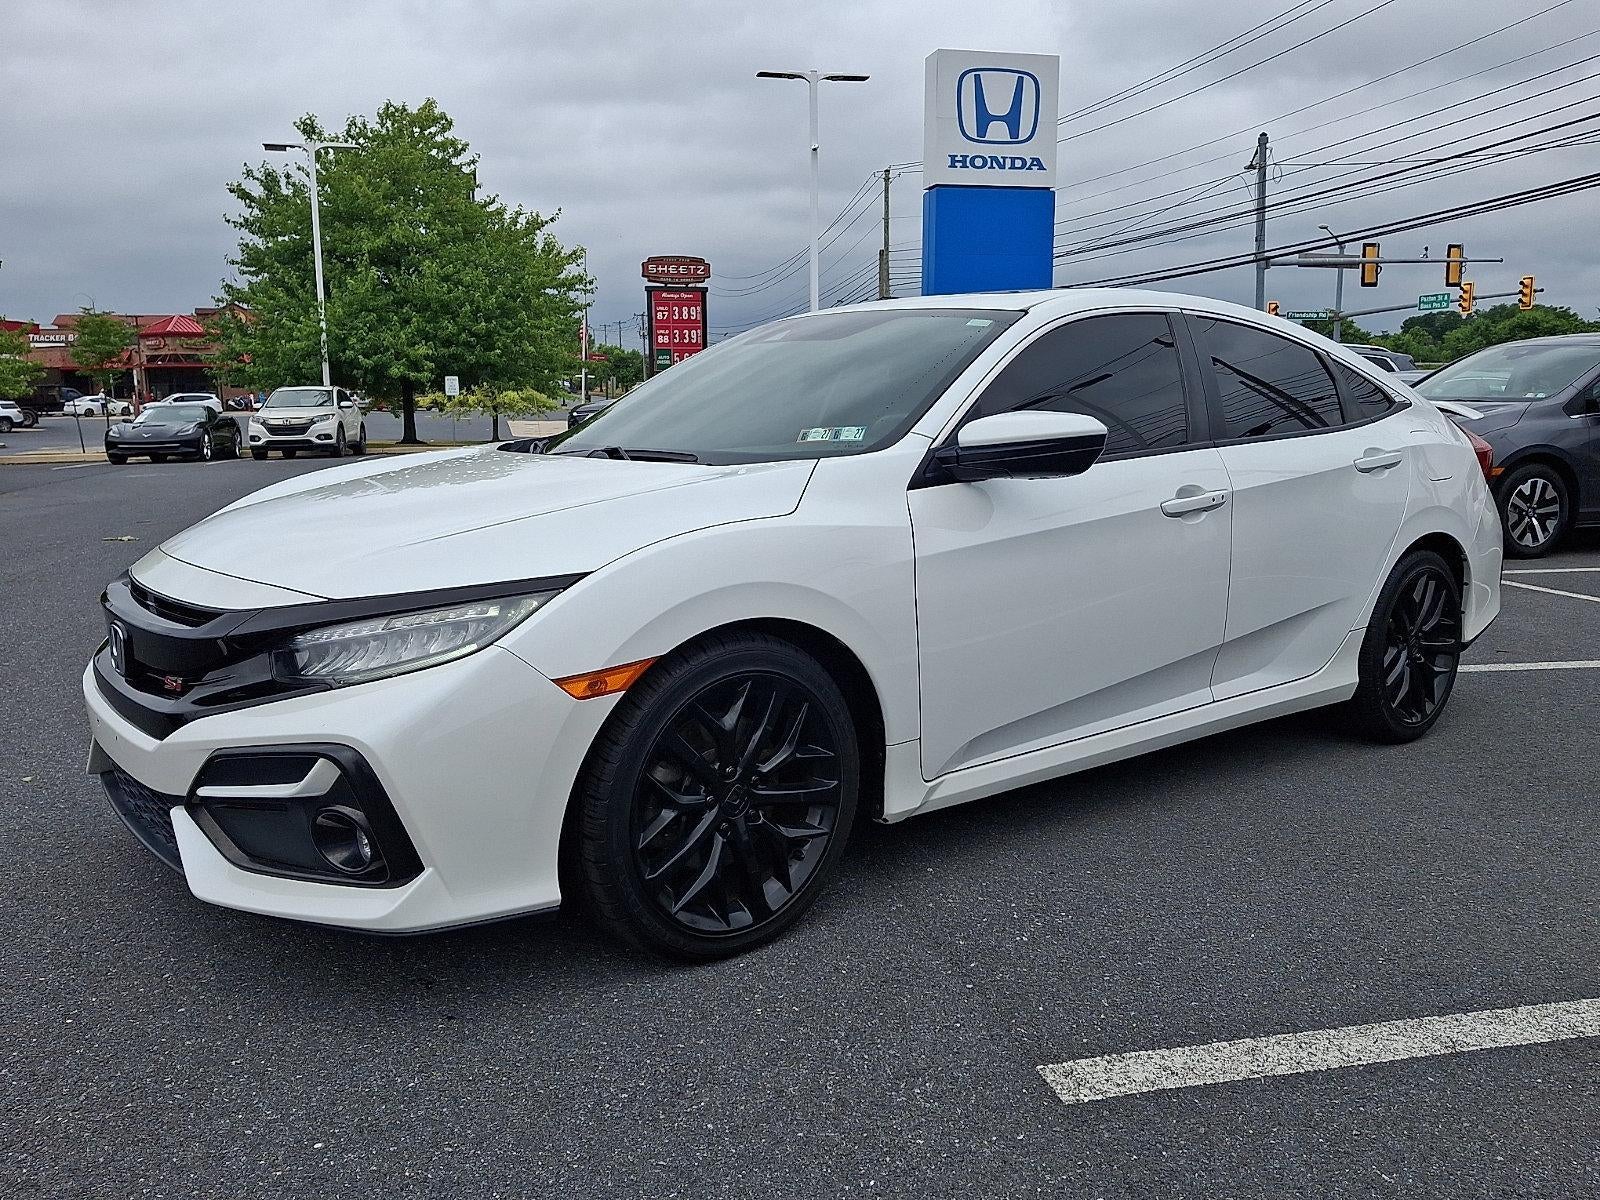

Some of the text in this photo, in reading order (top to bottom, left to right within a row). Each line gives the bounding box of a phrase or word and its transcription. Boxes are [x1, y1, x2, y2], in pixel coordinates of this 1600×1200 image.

[947, 154, 1047, 171] HONDA
[648, 264, 705, 275] SHEETZ
[656, 311, 669, 320] 87
[672, 306, 696, 320] 3.89
[28, 333, 65, 342] TRACKER
[657, 335, 670, 344] 88
[673, 329, 697, 344] 3.39
[853, 428, 864, 439] 27
